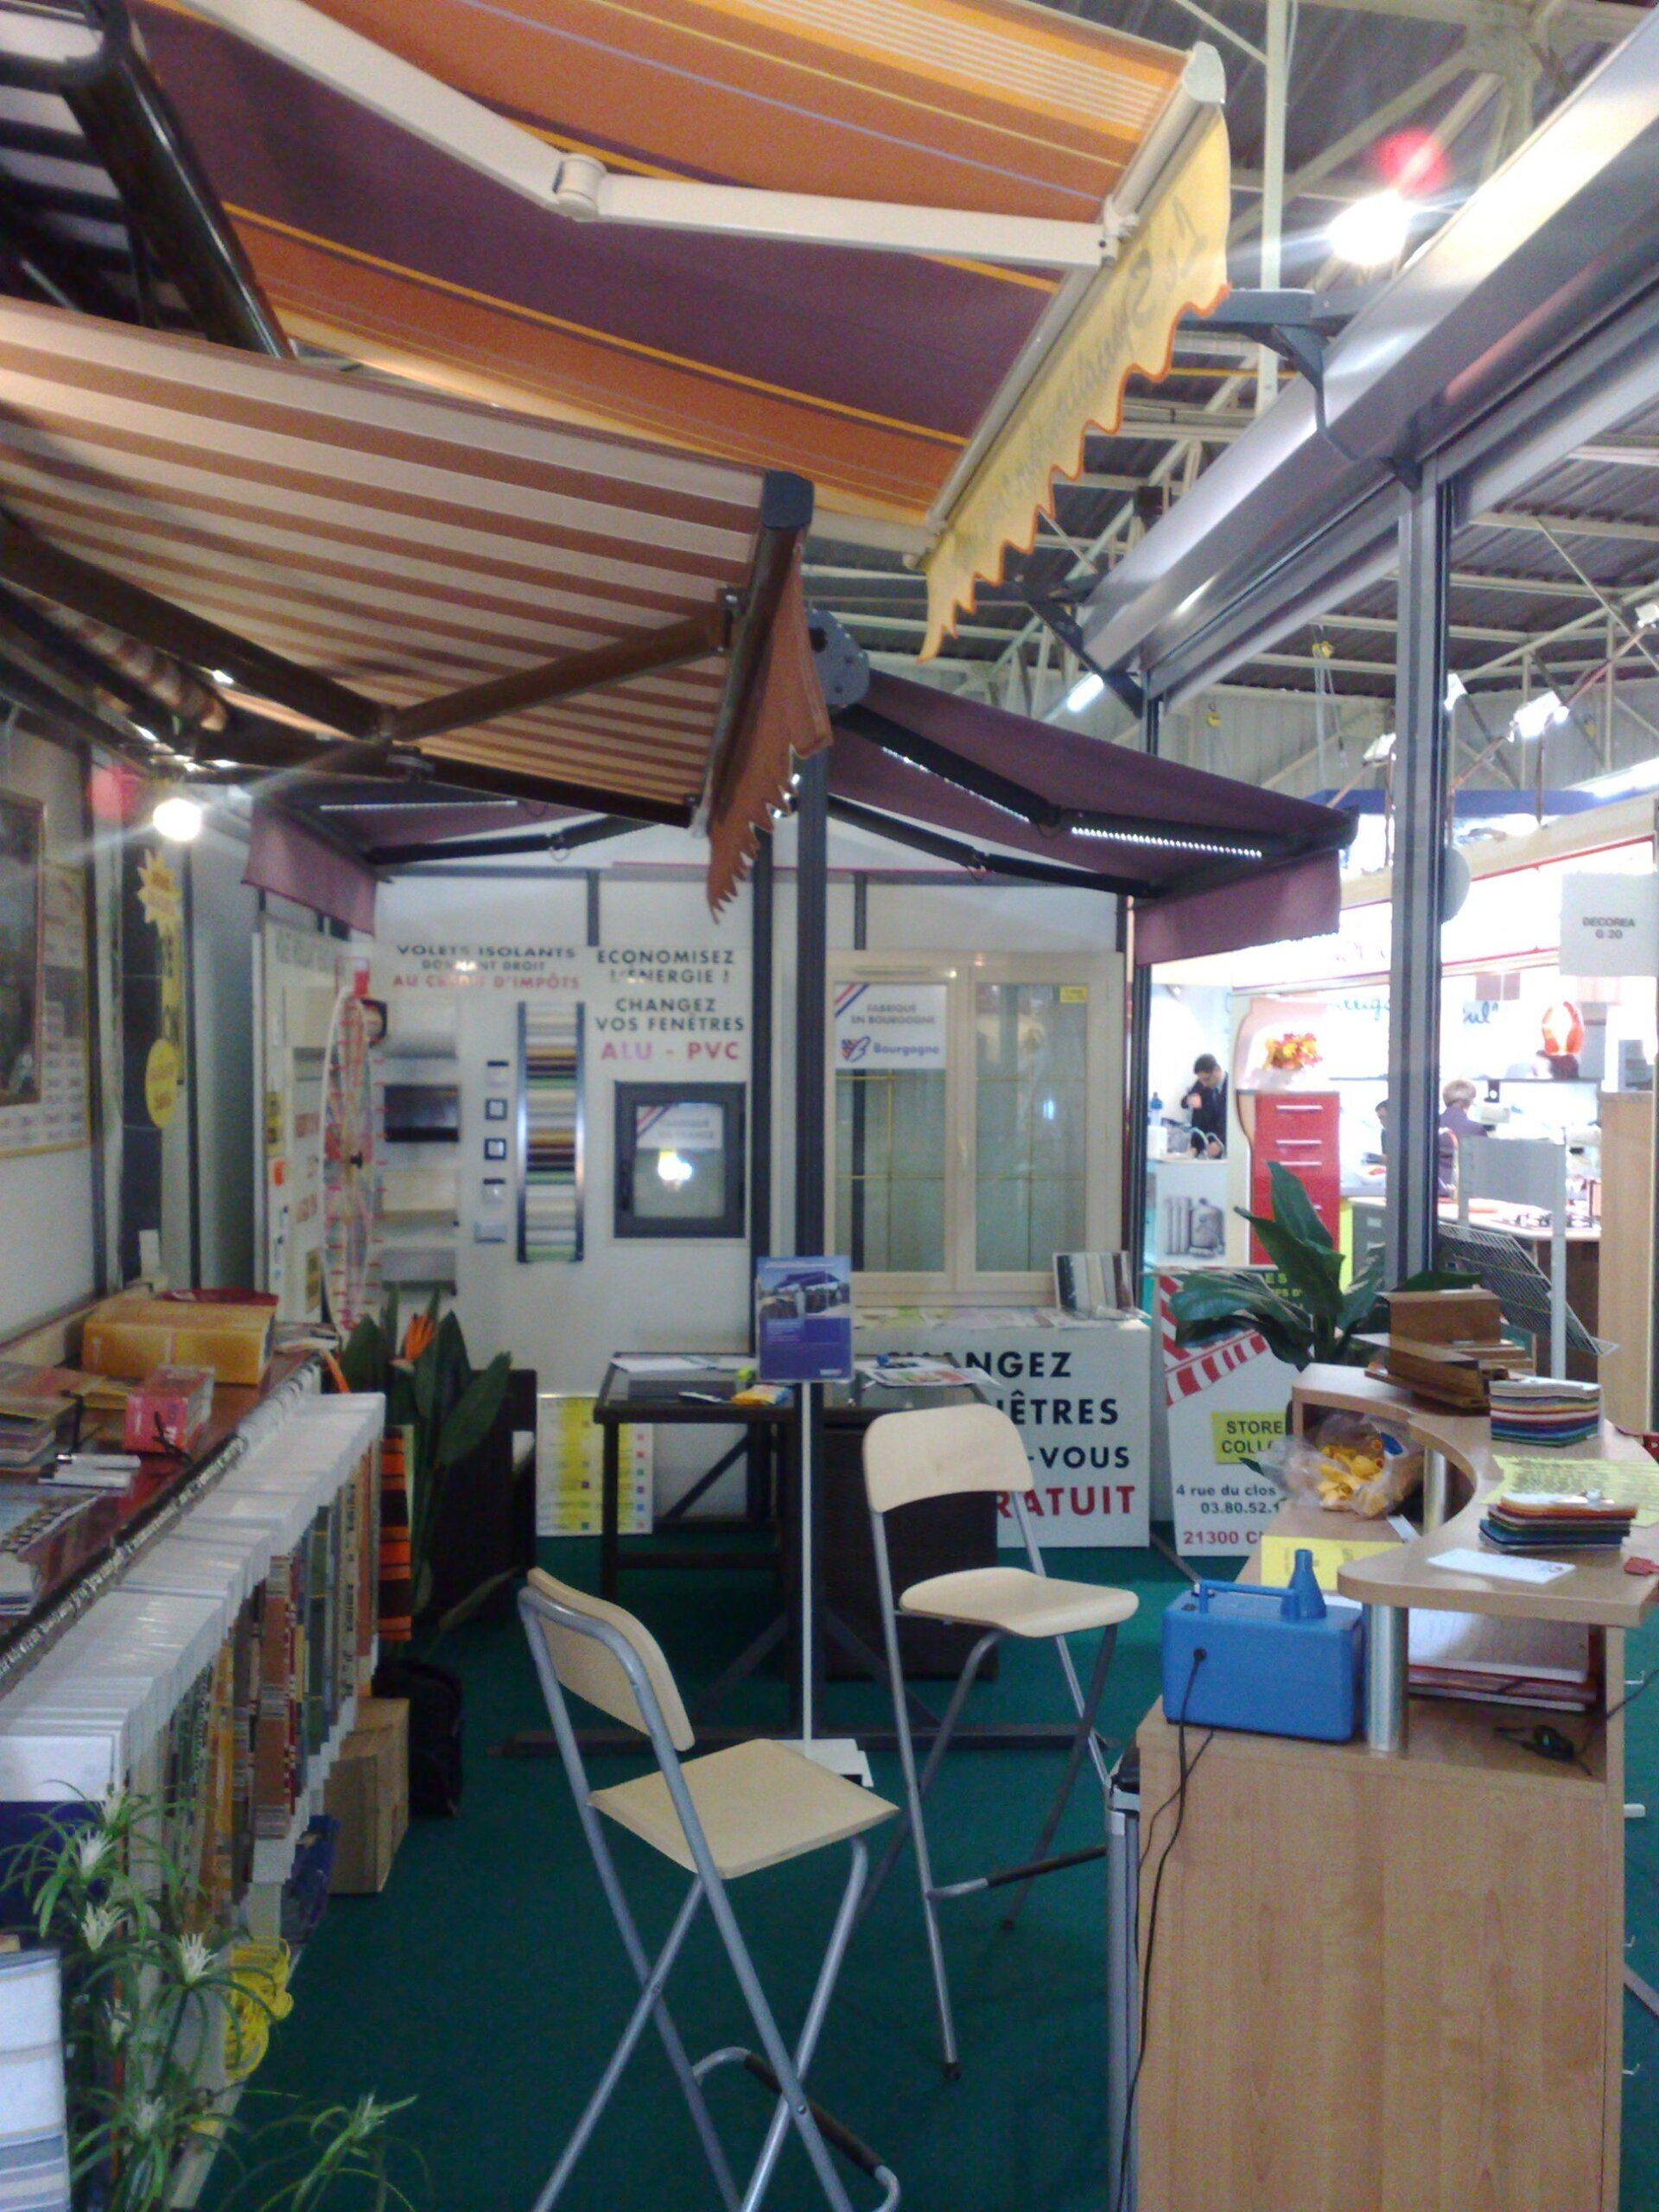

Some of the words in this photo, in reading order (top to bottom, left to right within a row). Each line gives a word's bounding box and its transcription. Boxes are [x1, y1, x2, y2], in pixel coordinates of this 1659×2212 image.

[397, 944, 470, 957] VOLETS
[479, 946, 575, 958] ISOLANTS
[502, 961, 545, 971] DROIT
[392, 975, 418, 987] AU
[615, 997, 715, 1013] CHANGEZ
[595, 1017, 638, 1032] VOS
[601, 1041, 652, 1060] ALU
[688, 1040, 739, 1060] PVC
[874, 1042, 939, 1056] Bourgogne
[1176, 1484, 1185, 1496] 4
[1191, 1486, 1215, 1496] rue
[1221, 1484, 1239, 1496] du
[1244, 1484, 1276, 1496] clos
[1184, 1530, 1239, 1545] 21300
